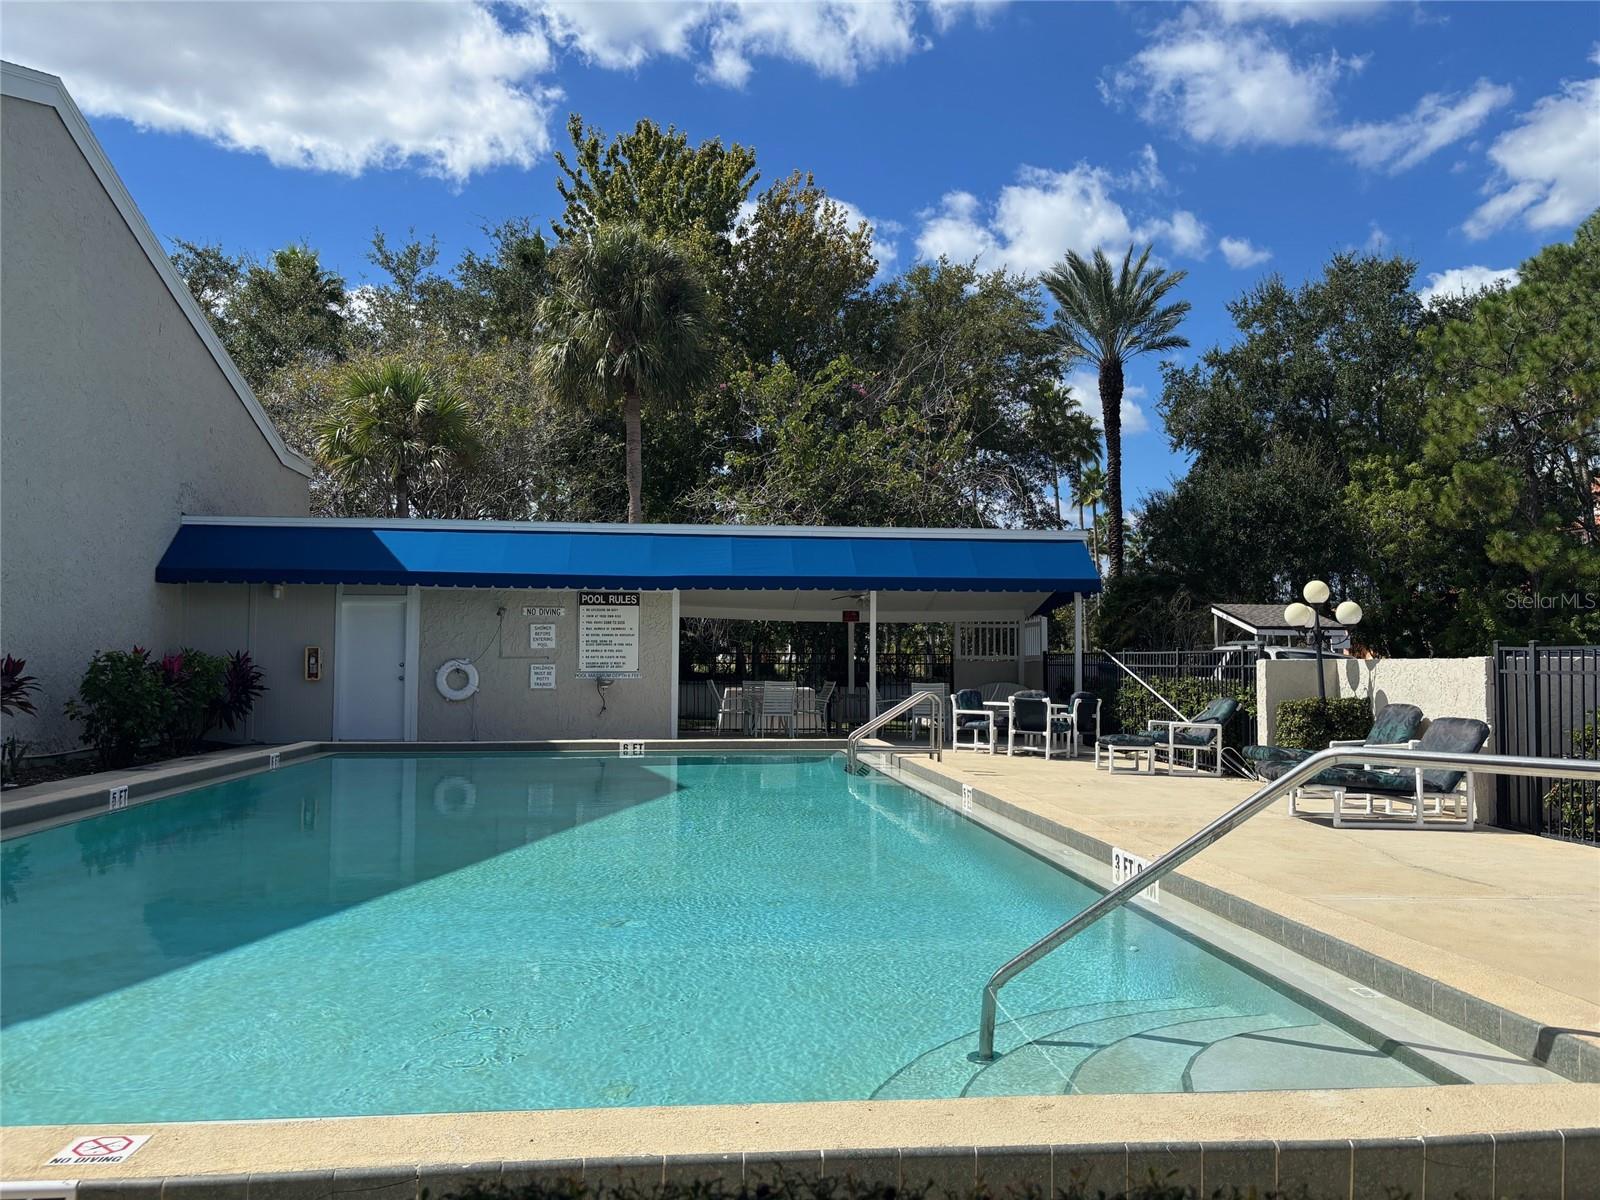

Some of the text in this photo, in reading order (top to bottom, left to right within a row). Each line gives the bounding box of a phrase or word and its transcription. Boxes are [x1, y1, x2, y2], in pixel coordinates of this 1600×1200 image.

[581, 594, 637, 604] POOL RULES
[540, 608, 561, 616] DIVING
[1115, 854, 1120, 870] 3
[1123, 857, 1133, 875] FT
[74, 1156, 122, 1164] DIVING
